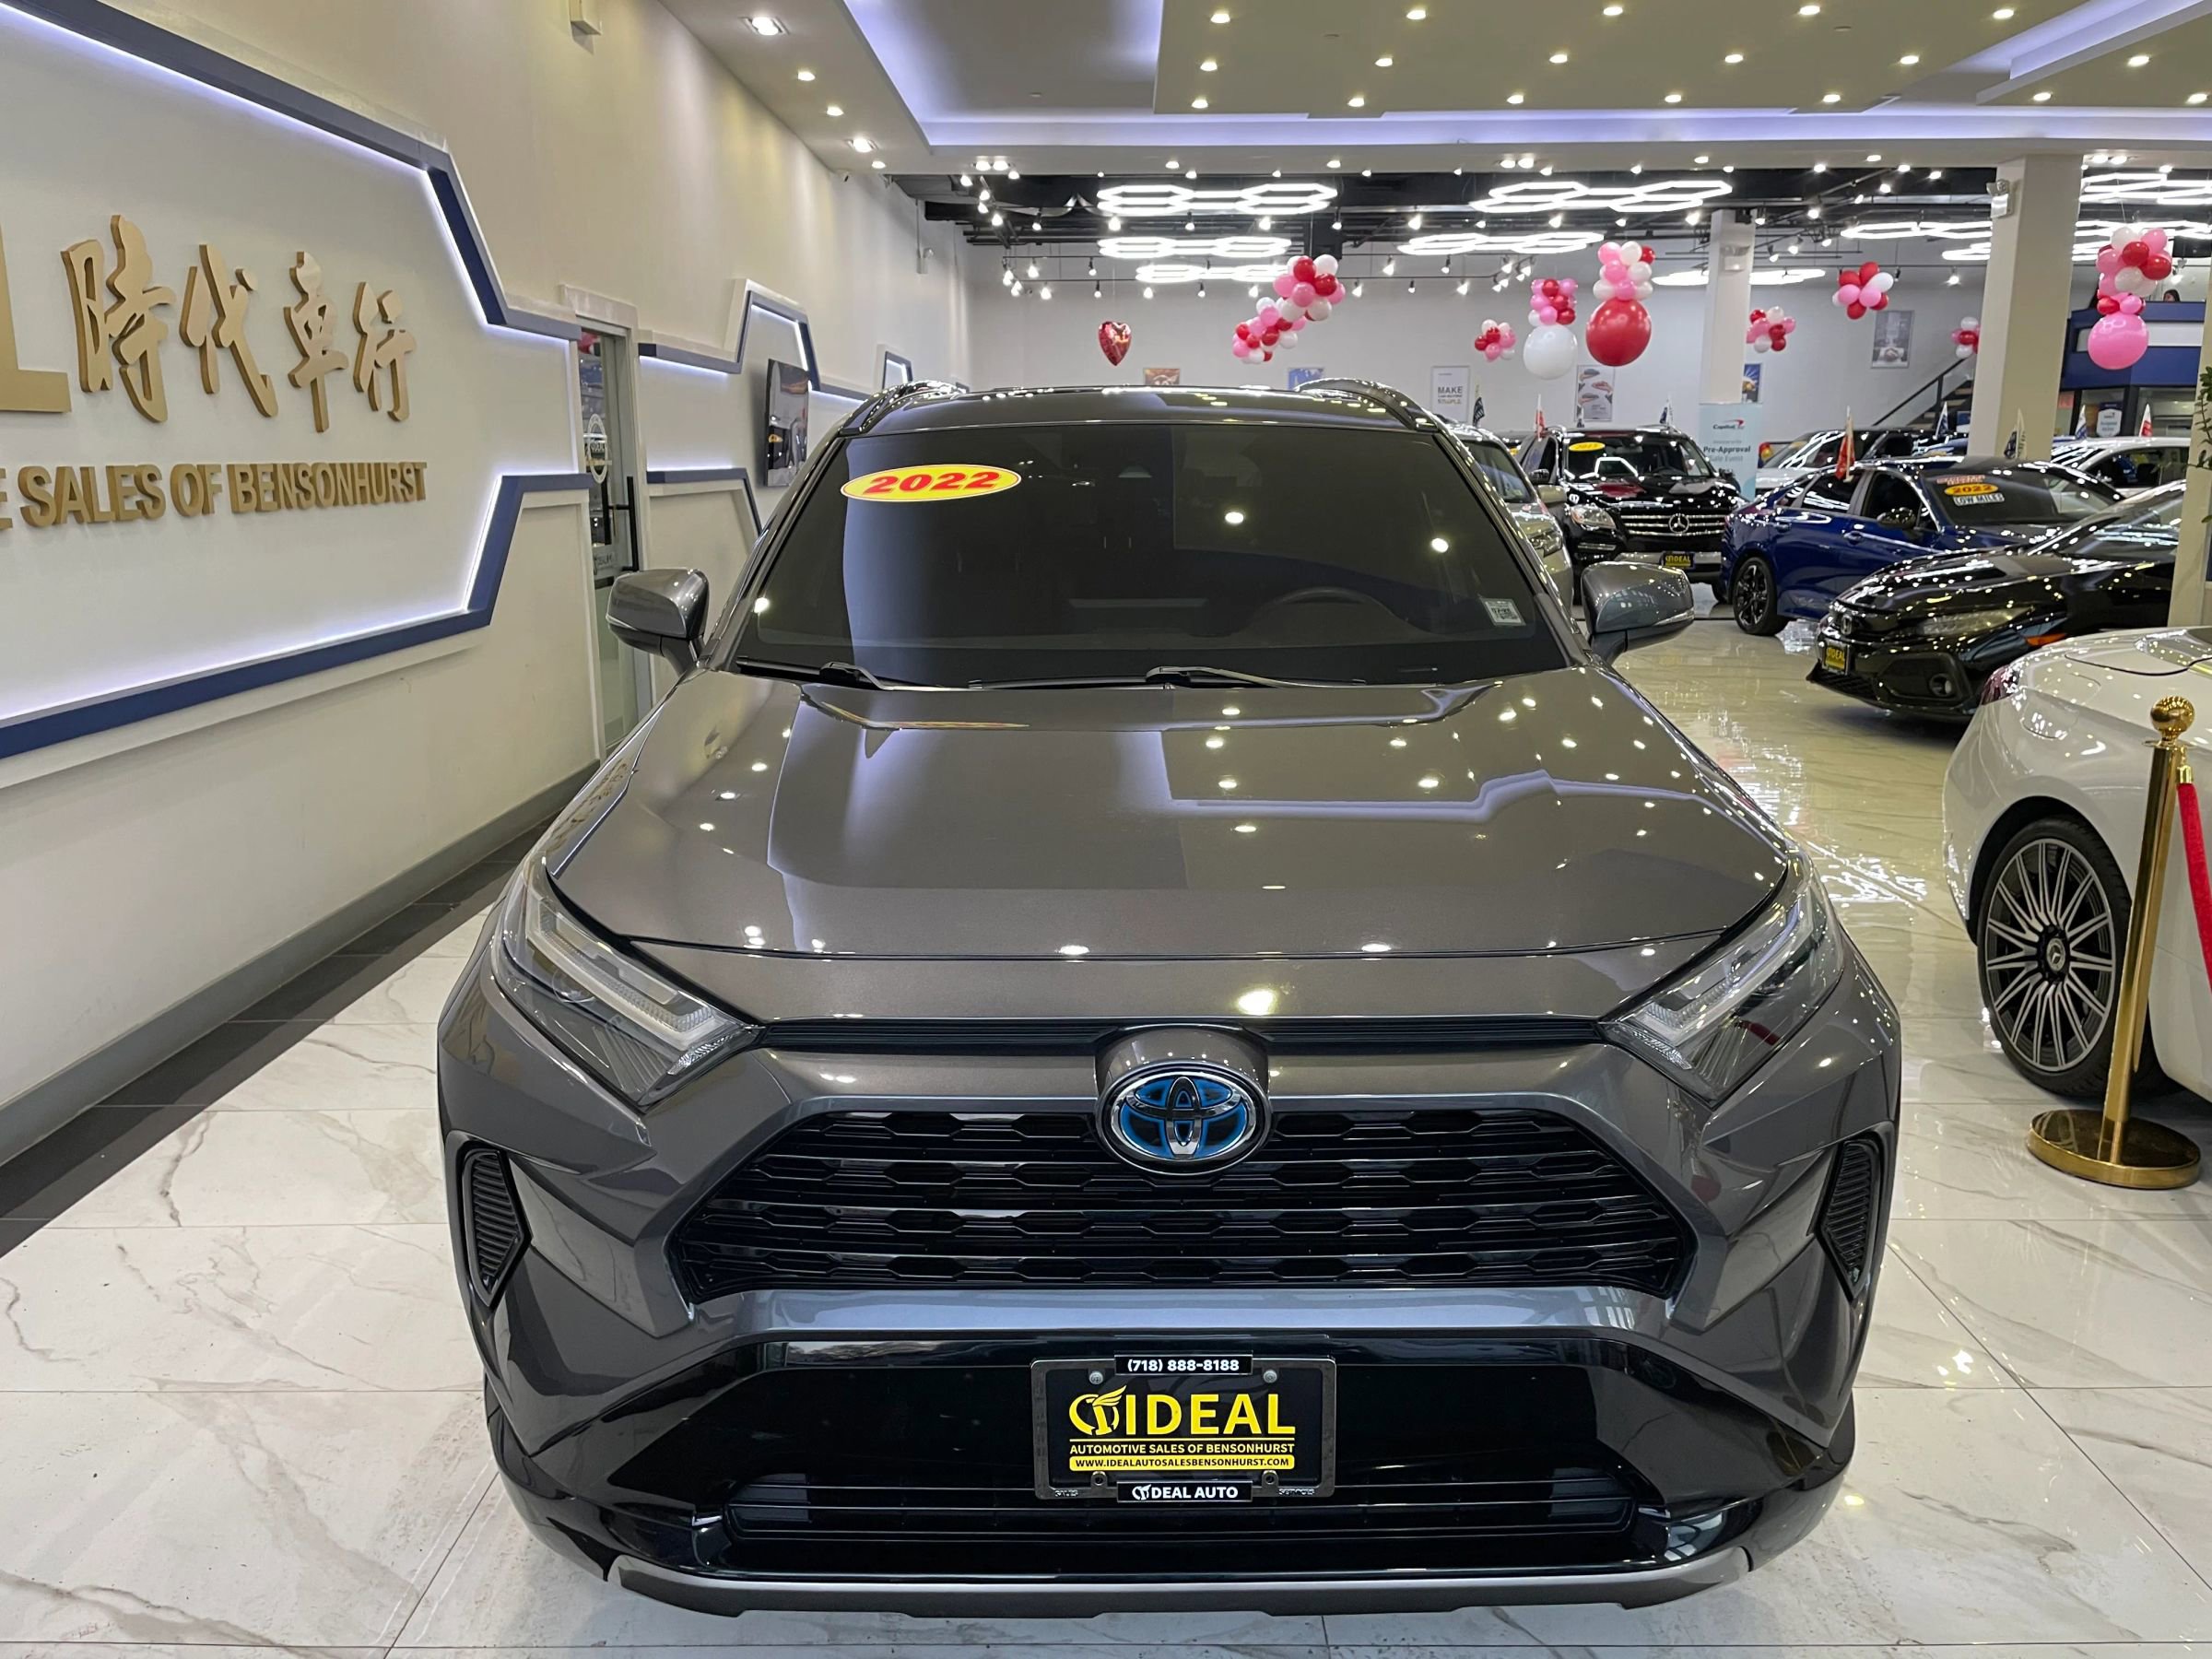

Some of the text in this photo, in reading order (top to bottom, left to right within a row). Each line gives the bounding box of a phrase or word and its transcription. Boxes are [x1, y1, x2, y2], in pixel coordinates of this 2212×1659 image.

[1703, 445, 1750, 453] Pre-Approval
[863, 472, 1000, 495] 2022
[18, 465, 166, 527] SALES
[170, 464, 222, 516] OF
[227, 462, 427, 513] BENSONHURST
[1127, 1359, 1240, 1371] (718) 888-8188
[1125, 1394, 1296, 1435] IDEAL
[1069, 1443, 1295, 1454] AUTOMOTIVE SALES OF BENSONHURST
[1076, 1458, 1289, 1467] WWW.IDEALAUTOSALESBENSONHURST.COM
[1194, 1487, 1239, 1499] AUTO
